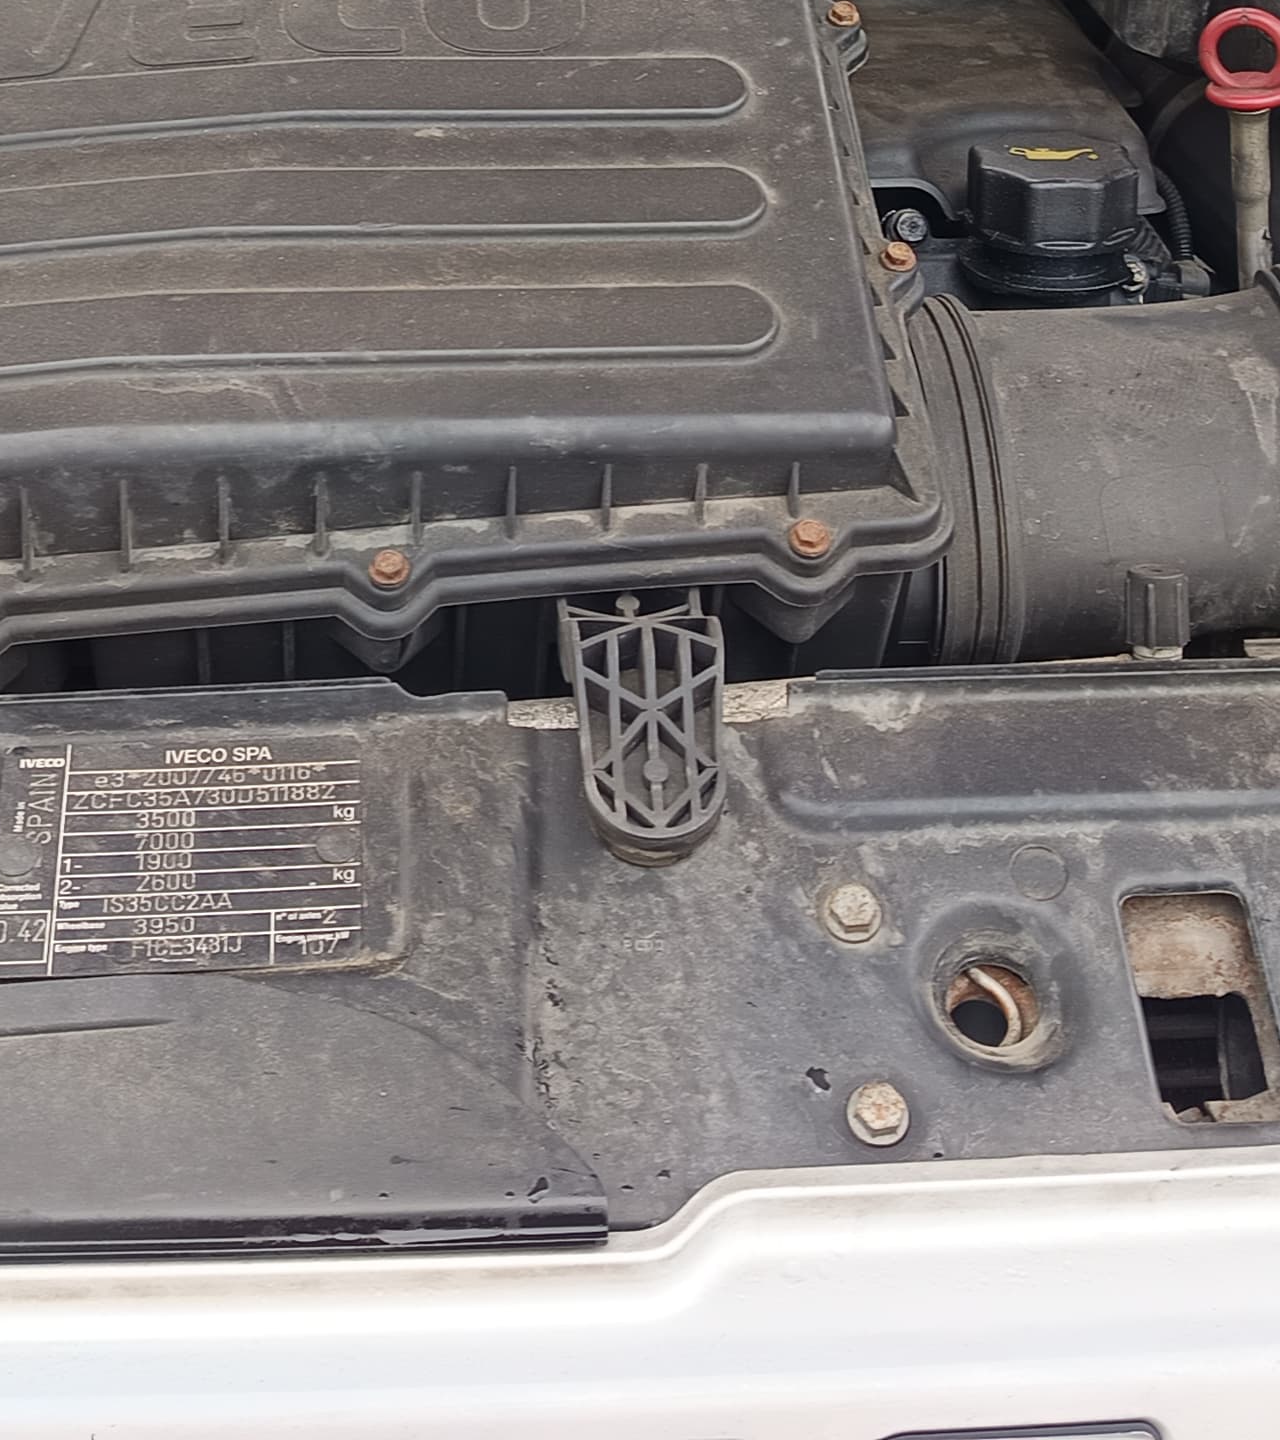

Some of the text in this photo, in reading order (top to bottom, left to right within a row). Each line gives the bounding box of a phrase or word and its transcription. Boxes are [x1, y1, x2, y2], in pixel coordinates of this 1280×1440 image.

[19, 757, 65, 769] IVECO
[165, 746, 273, 765] IVECO SPA
[25, 772, 58, 845] SPAIN
[135, 804, 356, 829] 3500 kg
[135, 831, 196, 851] 7000
[62, 852, 193, 873] 1- 1900
[59, 867, 356, 895] 2- 2600 kg
[59, 900, 81, 910] Type
[132, 916, 196, 935] 3950
